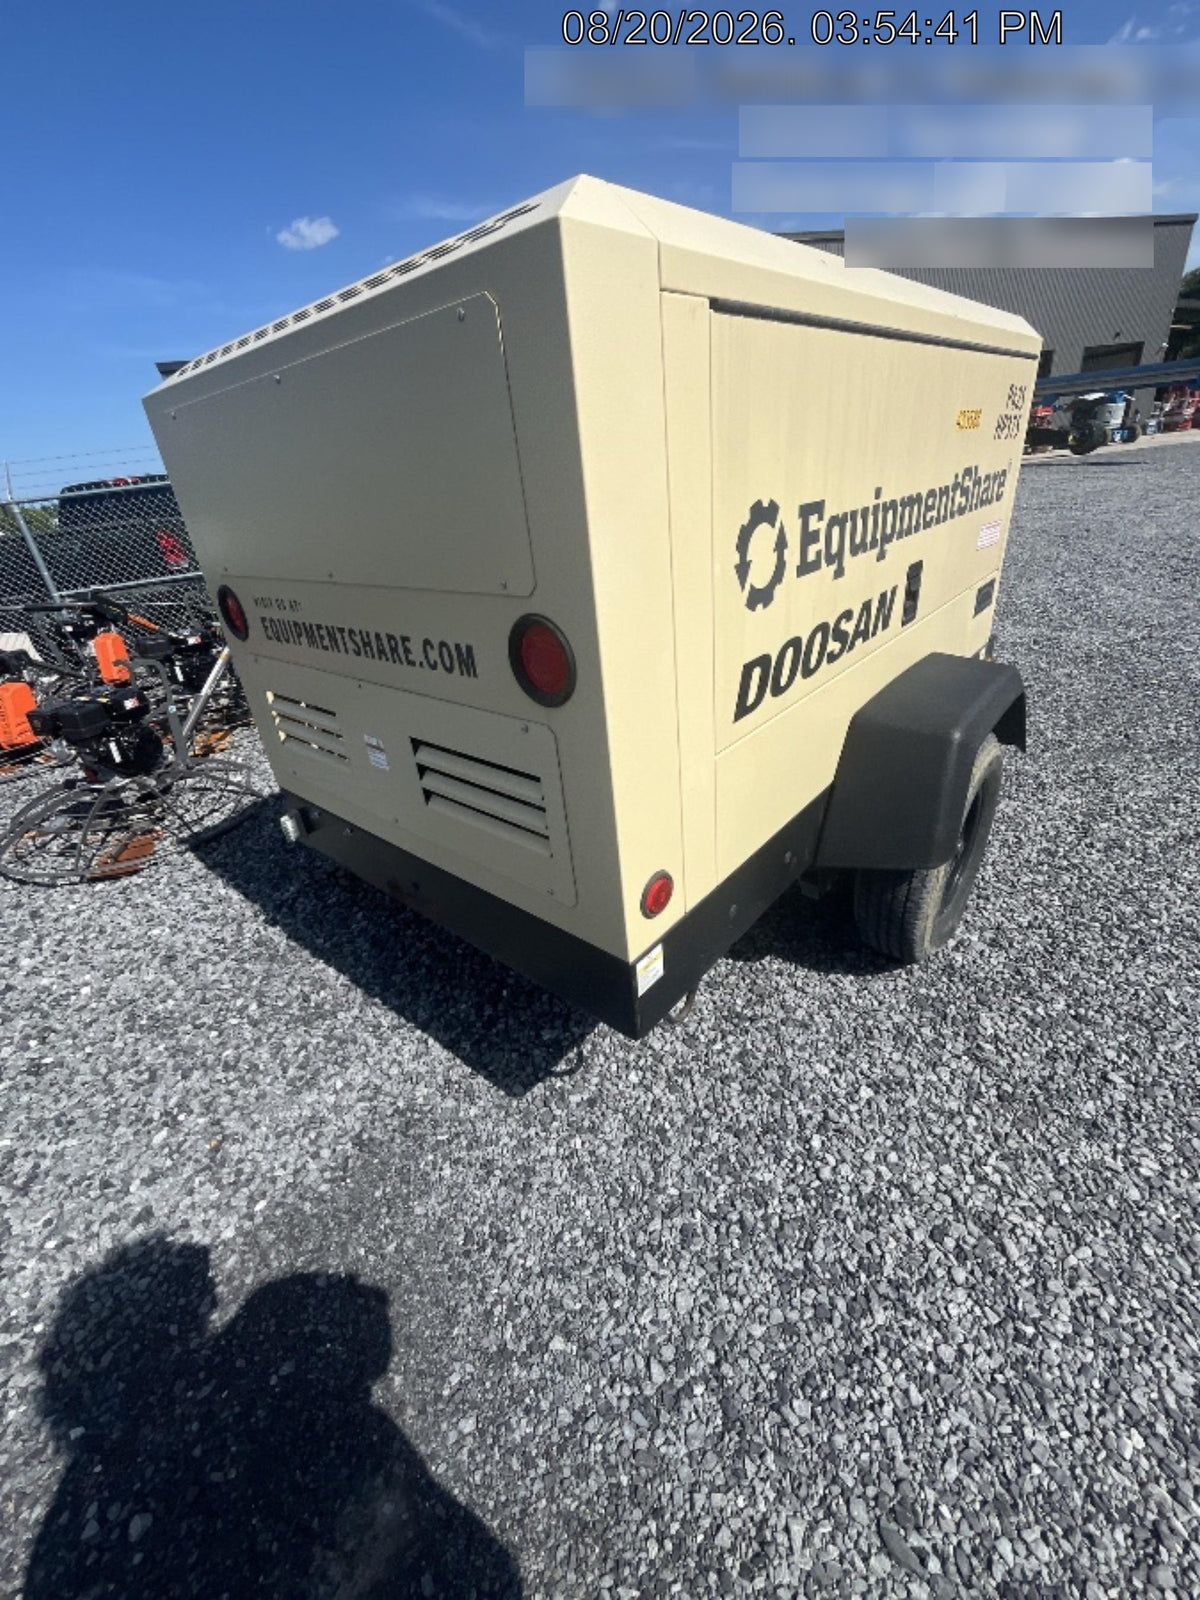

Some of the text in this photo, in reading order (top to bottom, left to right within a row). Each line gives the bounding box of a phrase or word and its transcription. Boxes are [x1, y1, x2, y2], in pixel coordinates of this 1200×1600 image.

[796, 466, 1007, 581] EquipmentShare
[260, 615, 479, 679] EQUIPMENTSHARE.COM
[733, 584, 898, 723] DOOSAN
